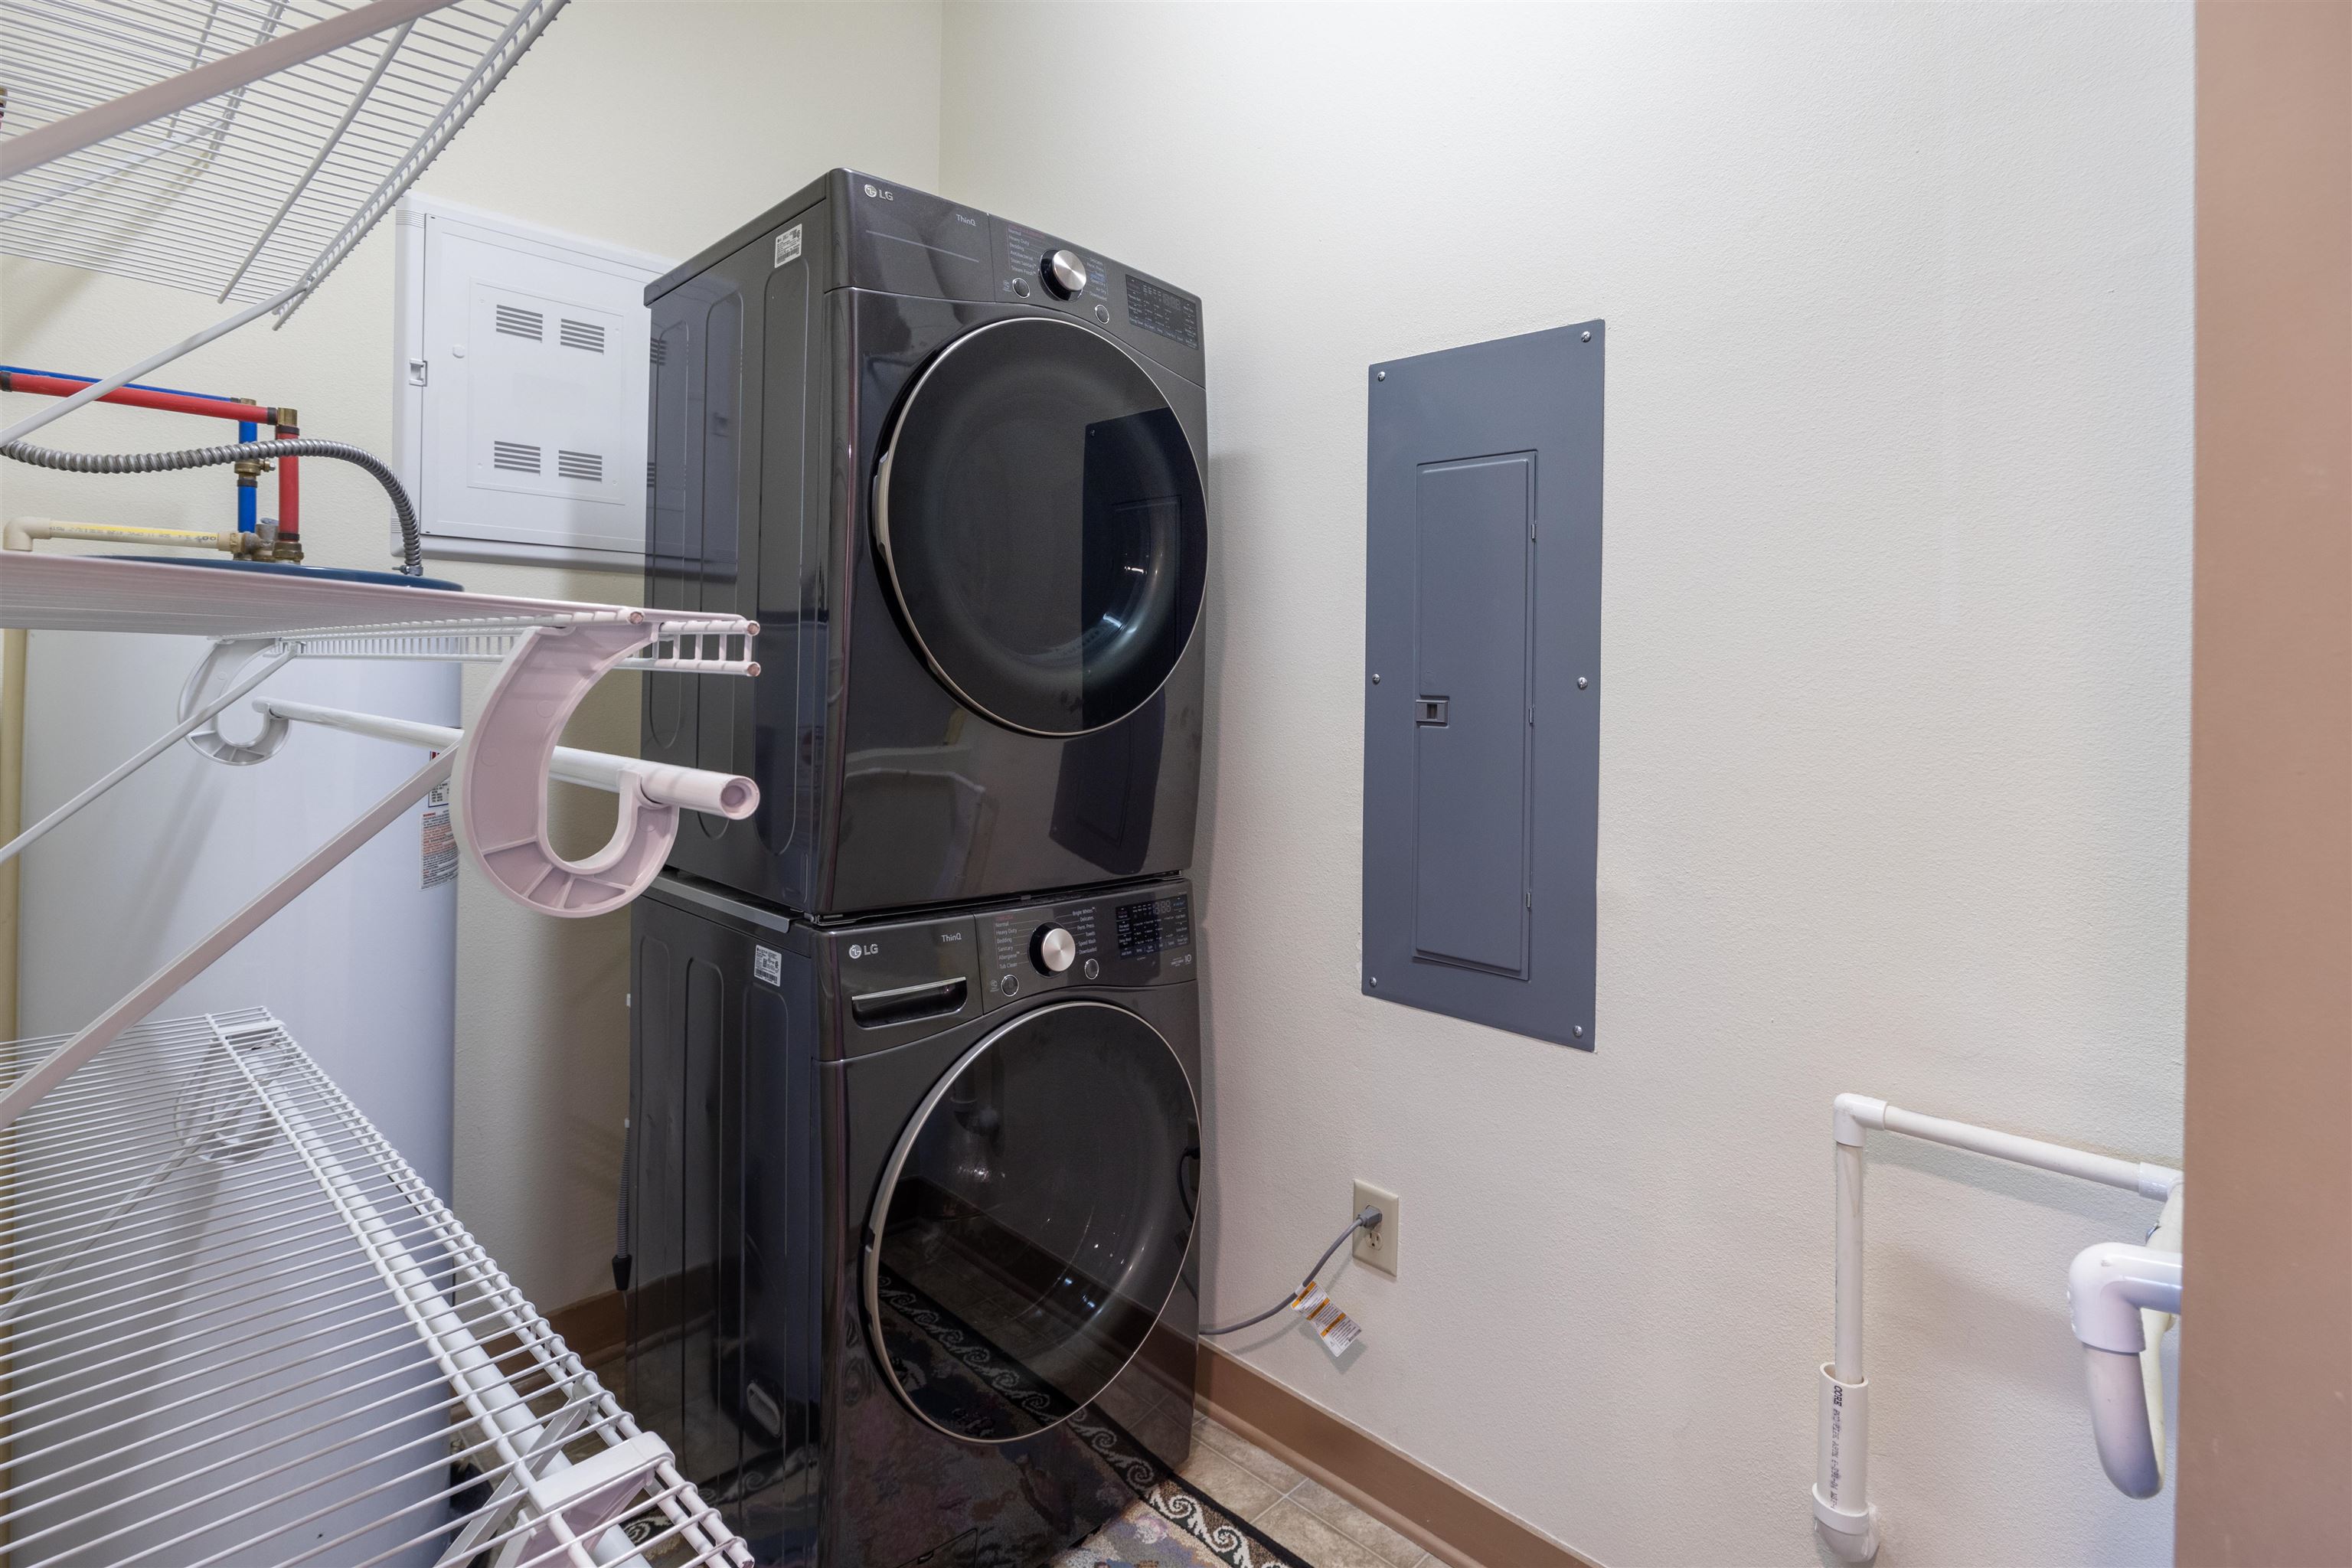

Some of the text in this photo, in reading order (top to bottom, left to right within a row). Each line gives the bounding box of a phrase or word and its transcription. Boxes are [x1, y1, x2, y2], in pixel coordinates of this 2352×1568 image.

[879, 189, 893, 201] LG
[956, 214, 977, 227] ThinQ
[940, 933, 962, 942] ThinQ
[864, 943, 878, 956] LG
[1079, 946, 1097, 955] Downloaded
[1834, 1385, 1842, 1407] CORE
